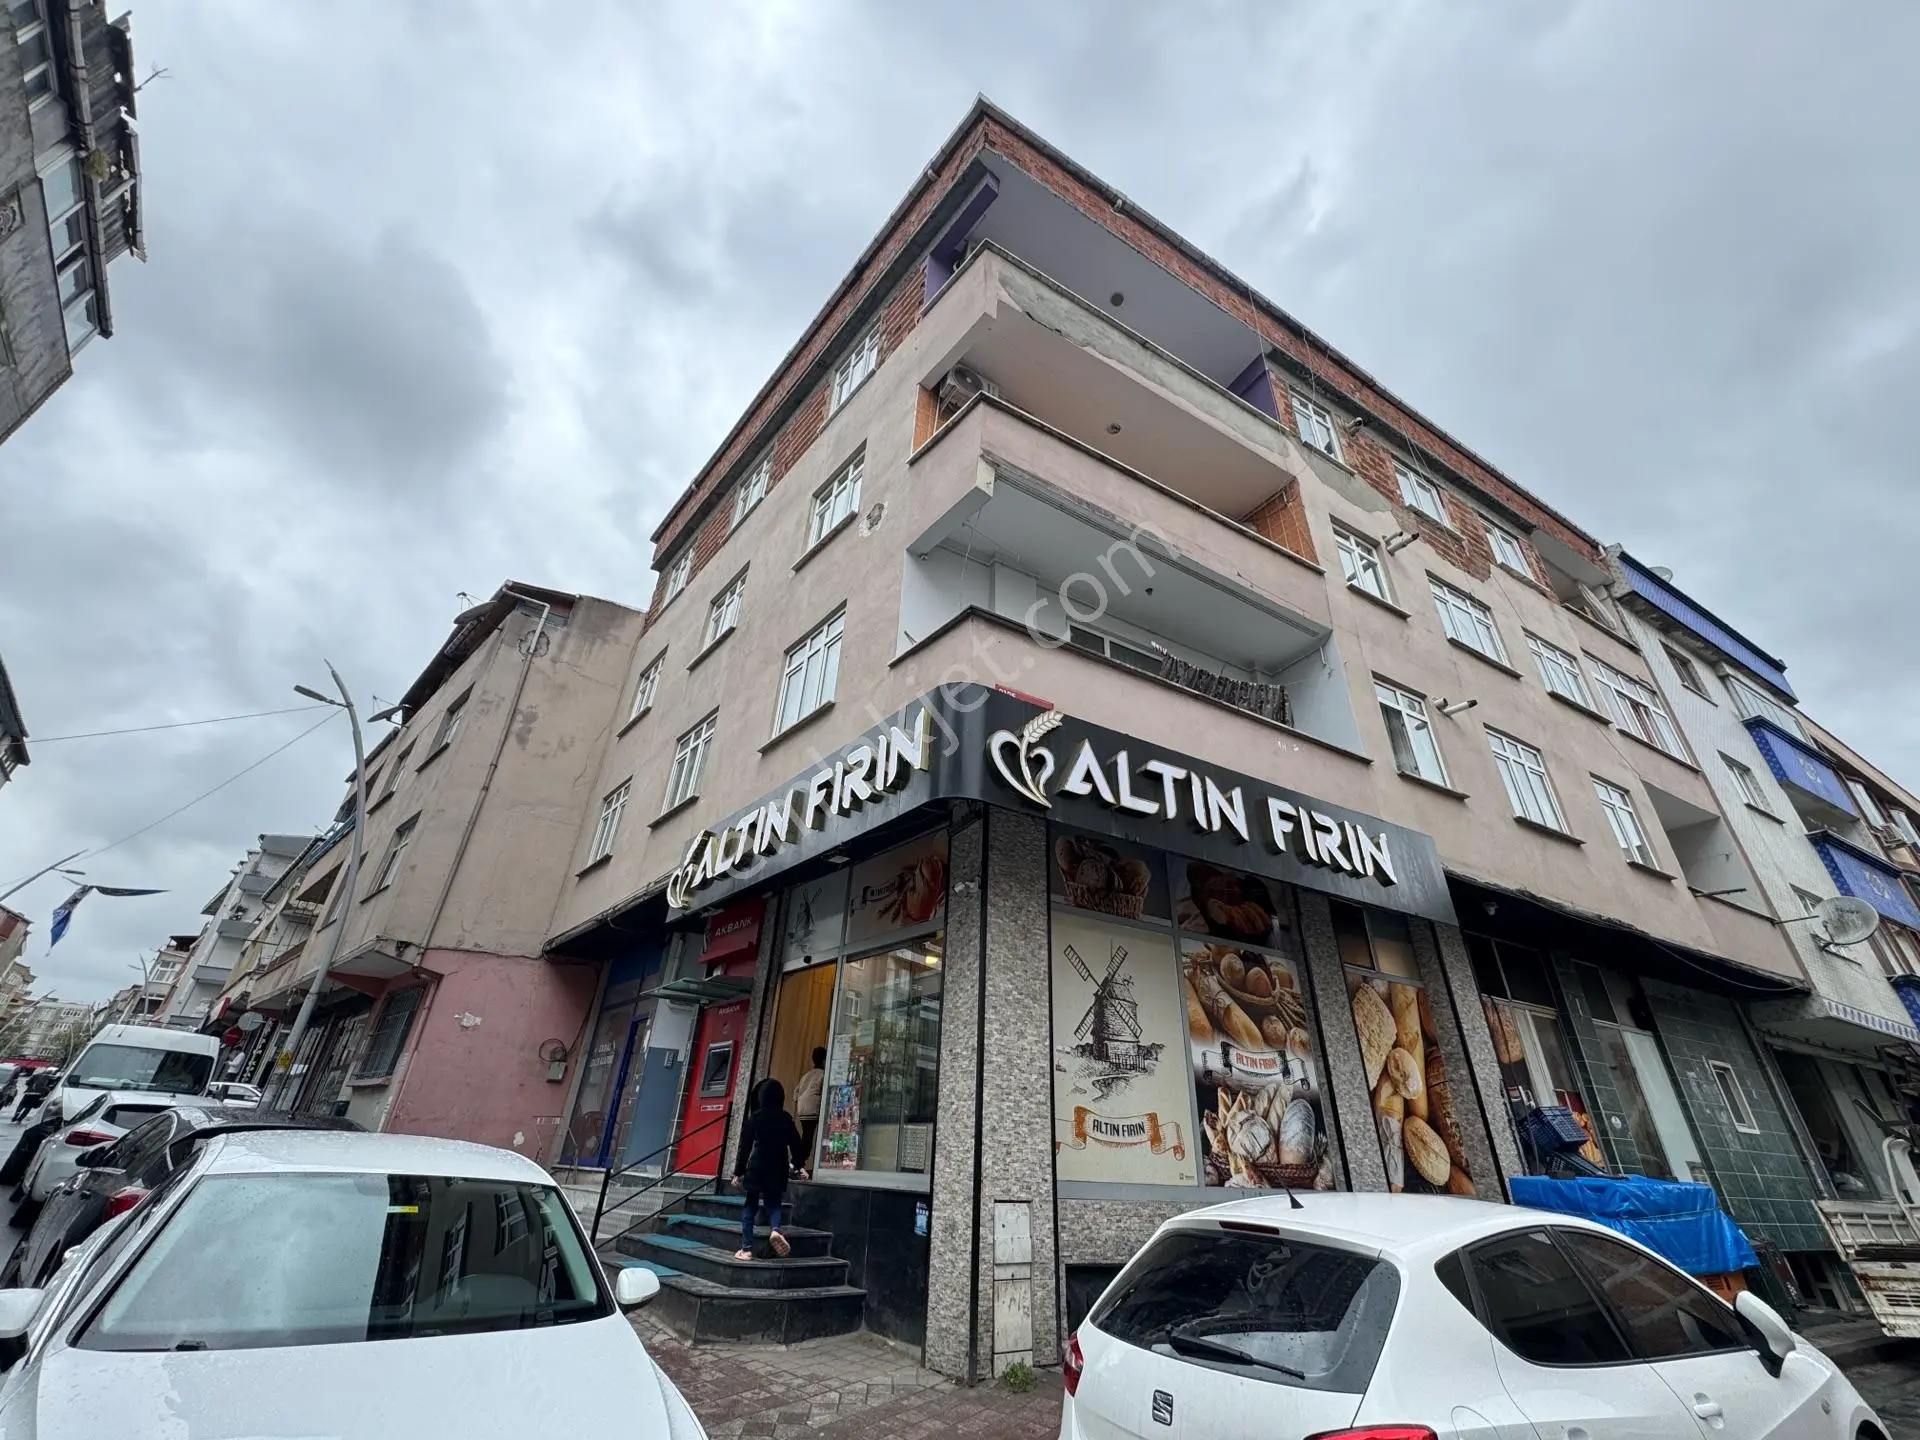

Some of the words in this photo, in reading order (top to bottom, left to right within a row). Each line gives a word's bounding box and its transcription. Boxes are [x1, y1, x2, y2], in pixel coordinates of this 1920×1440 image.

[691, 788, 803, 888] ALTIN
[806, 707, 930, 829] FIRIN
[1058, 738, 1250, 843] ALTIN
[1266, 795, 1398, 886] FIRIN
[714, 916, 753, 937] AKBANK
[1235, 1052, 1258, 1069] ALTIN
[1092, 1118, 1120, 1137] ALTIN
[1121, 1121, 1146, 1137] FIRIN
